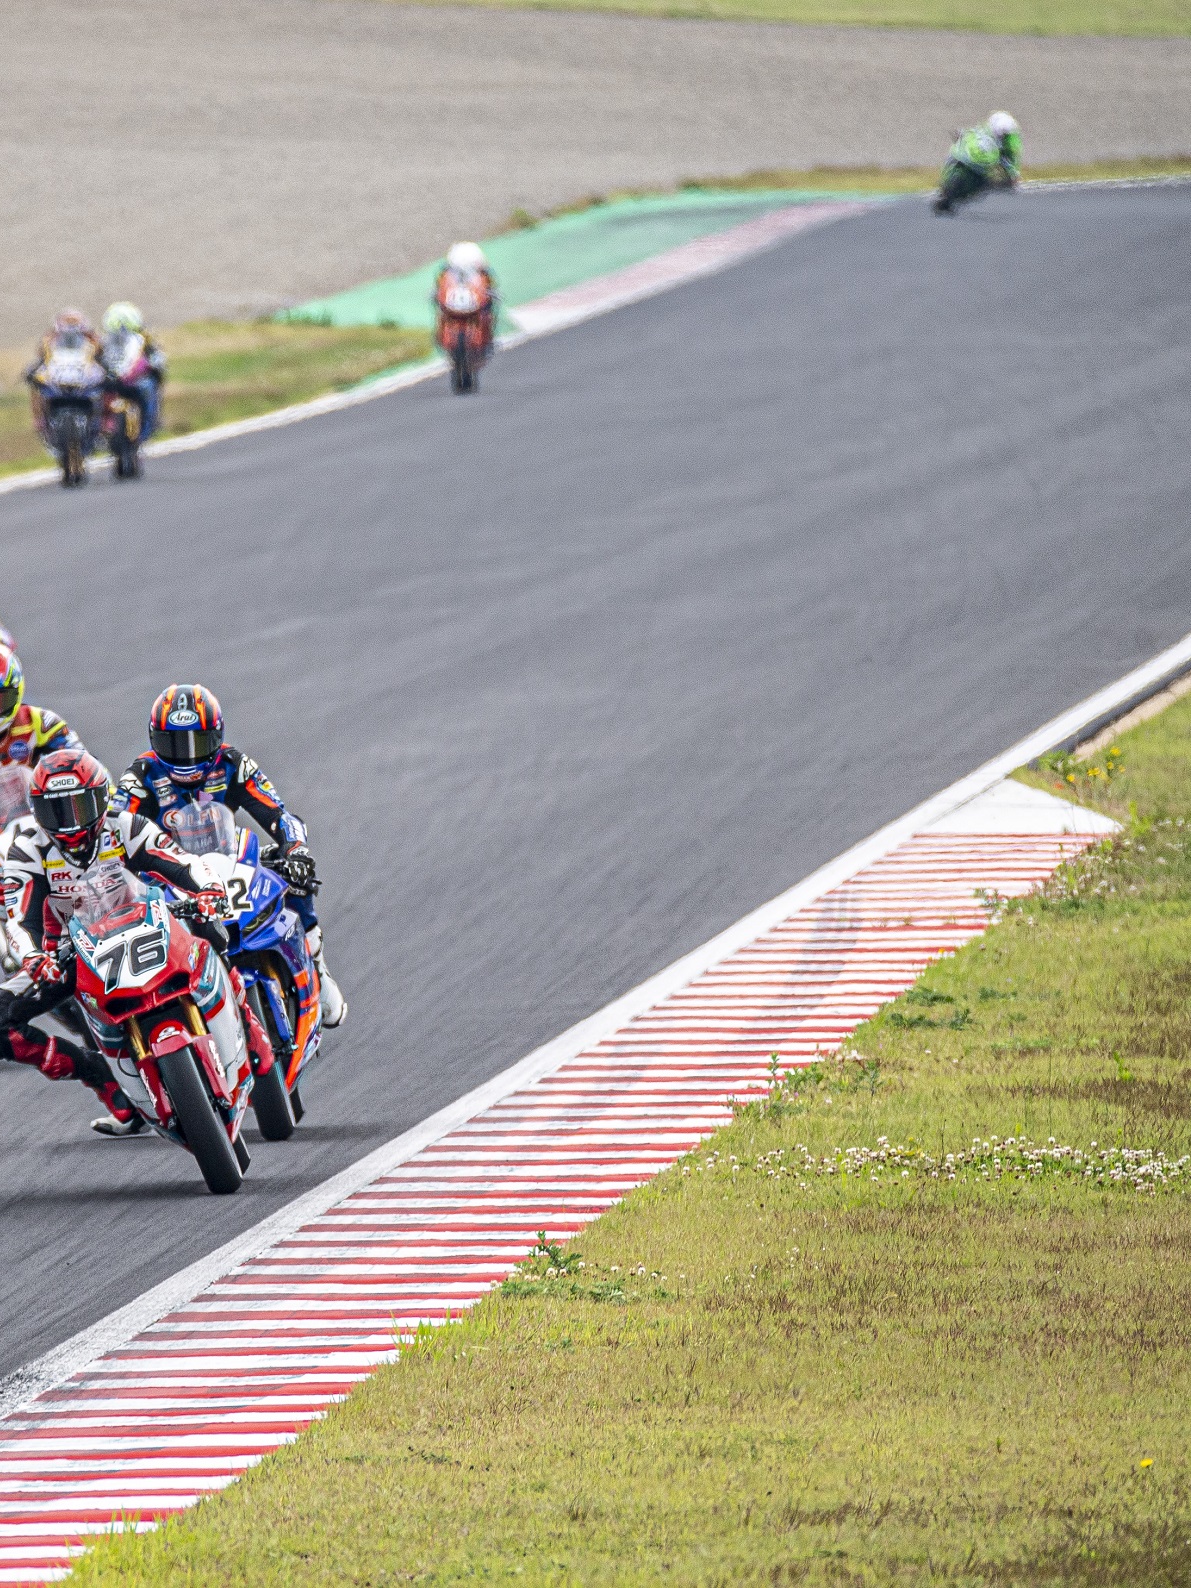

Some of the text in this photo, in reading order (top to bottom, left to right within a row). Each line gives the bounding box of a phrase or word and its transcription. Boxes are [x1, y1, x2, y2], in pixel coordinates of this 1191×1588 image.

[175, 712, 195, 721] Arai
[51, 778, 75, 788] SHOEI
[51, 871, 73, 881] RK
[227, 876, 254, 910] 2
[95, 929, 167, 995] 76
